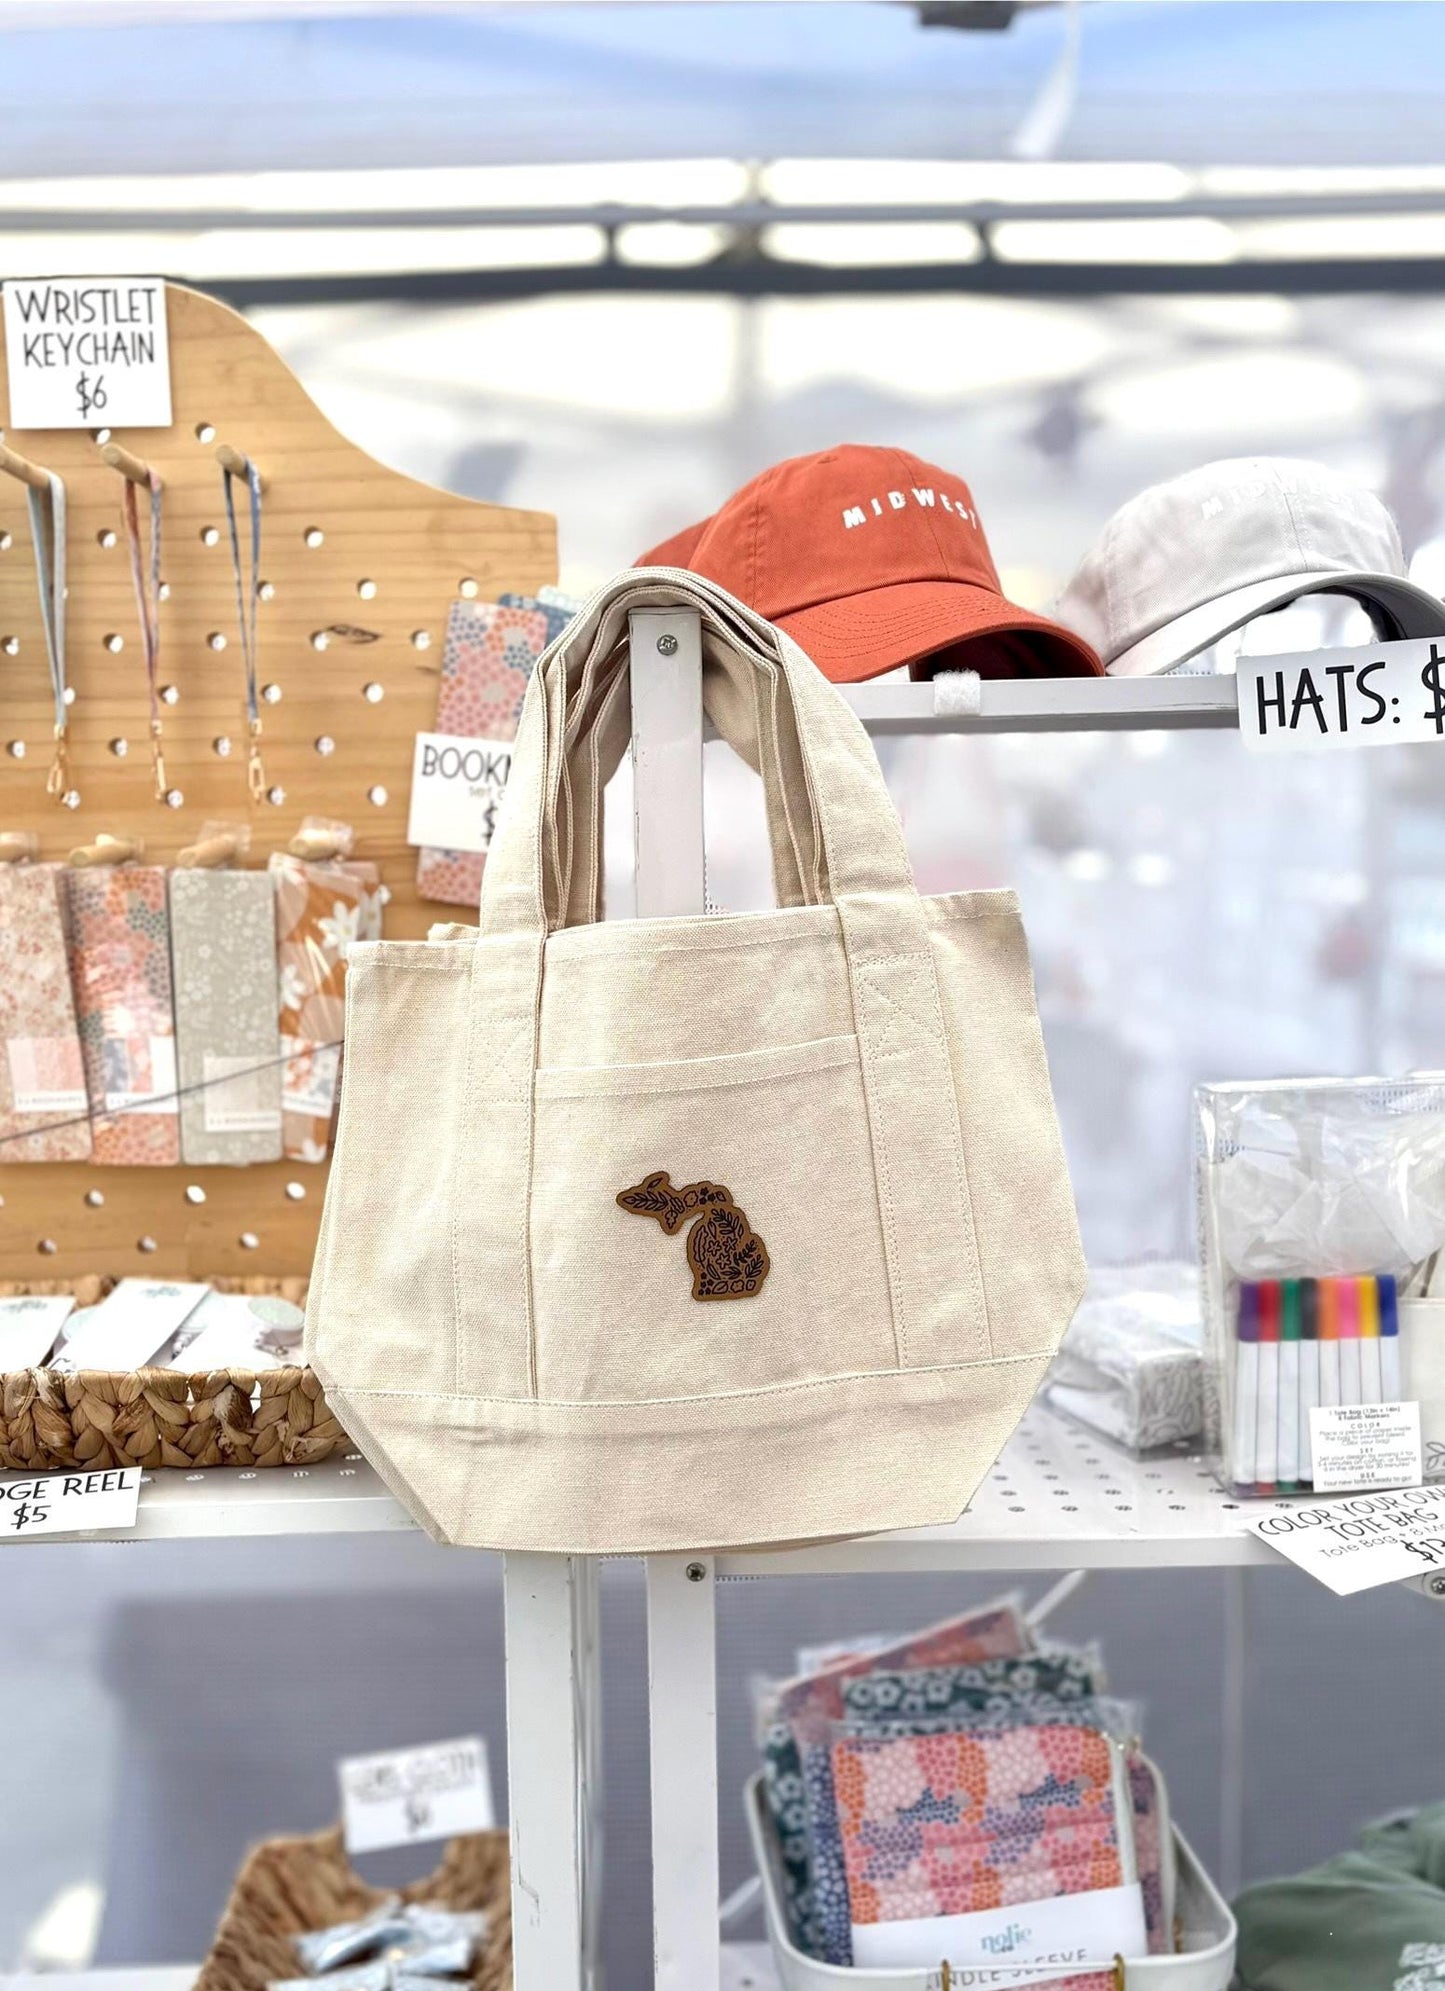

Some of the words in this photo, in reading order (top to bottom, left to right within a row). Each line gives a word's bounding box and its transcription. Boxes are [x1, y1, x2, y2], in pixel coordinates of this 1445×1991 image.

[15, 286, 157, 325] WRISTLET
[23, 330, 155, 368] KEYCHAIN
[76, 370, 107, 419] $6
[842, 487, 977, 530] MIDWEST
[1256, 661, 1399, 735] HATS:
[0, 1479, 50, 1501] GE
[62, 1471, 134, 1497] REEL
[10, 1502, 52, 1530] $5
[1258, 1509, 1342, 1535] COLOR
[1333, 1496, 1409, 1517] YOUR
[1403, 1487, 1445, 1504] OW
[1324, 1517, 1390, 1540] TOTE
[1383, 1508, 1439, 1527] BAG
[1319, 1543, 1359, 1558] Tote
[1359, 1535, 1398, 1548] Bag
